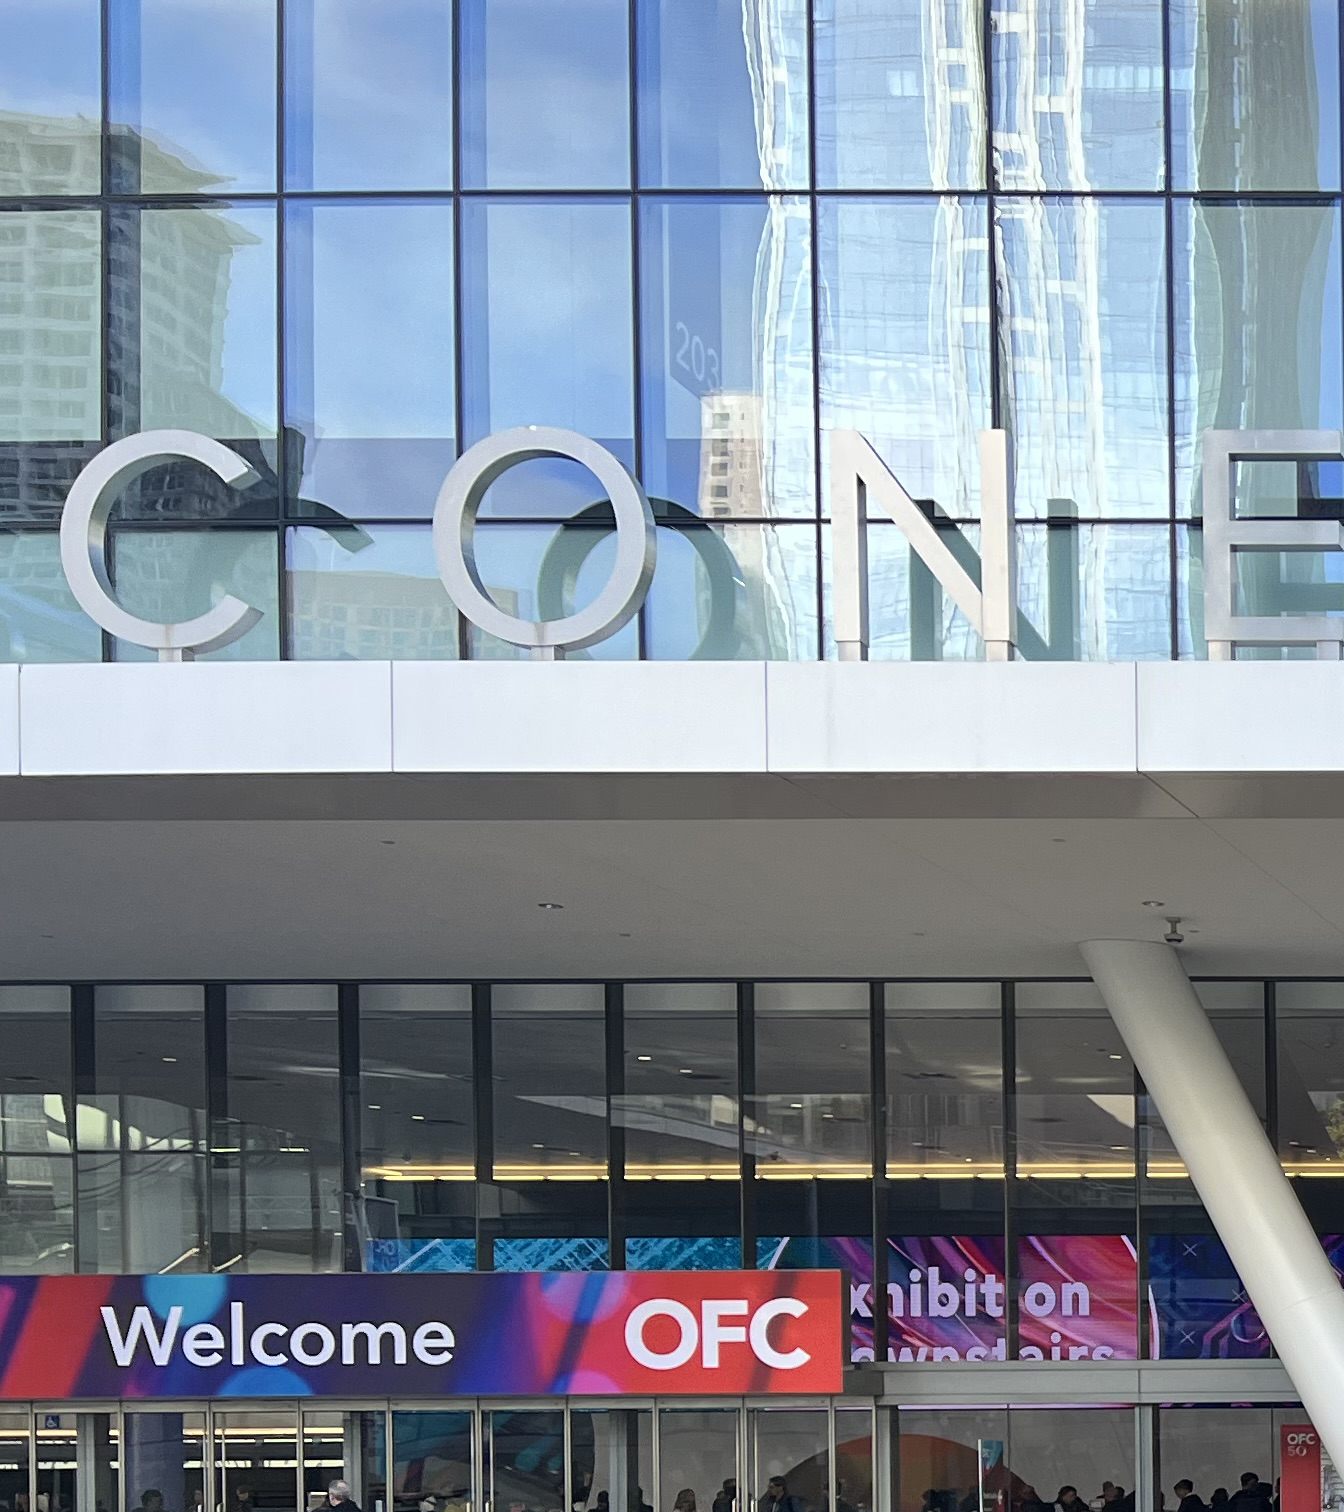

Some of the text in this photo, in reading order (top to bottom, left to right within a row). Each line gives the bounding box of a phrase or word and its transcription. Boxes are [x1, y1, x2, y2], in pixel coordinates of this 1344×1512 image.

[1024, 1281, 1090, 1318] on
[100, 1301, 457, 1367] Welcome
[624, 1298, 812, 1371] OFC
[1287, 1433, 1316, 1445] OFC
[1287, 1445, 1307, 1456] 50
